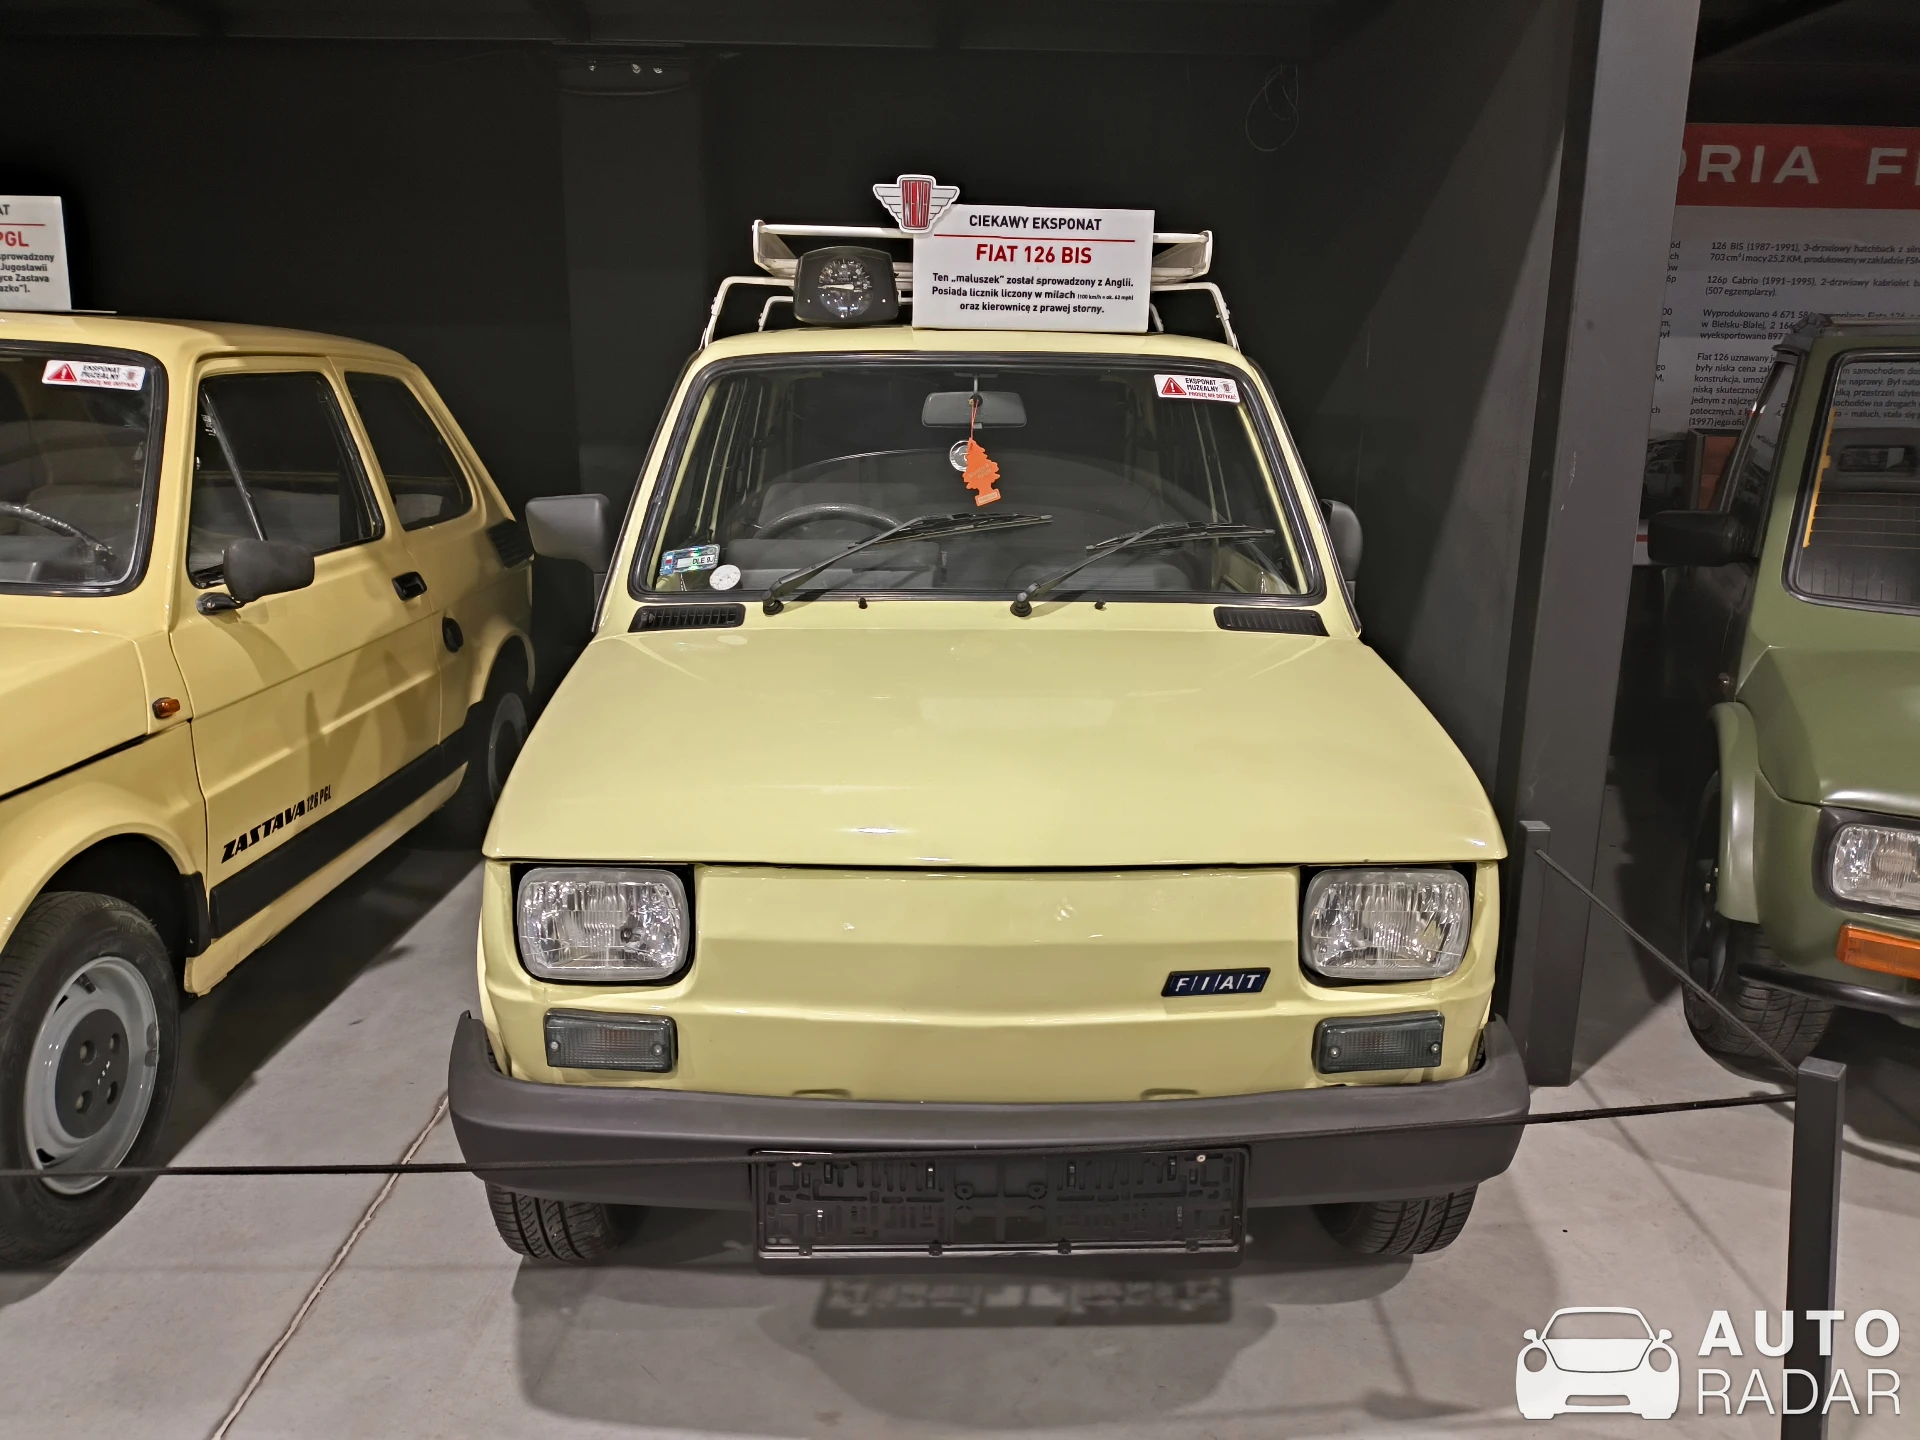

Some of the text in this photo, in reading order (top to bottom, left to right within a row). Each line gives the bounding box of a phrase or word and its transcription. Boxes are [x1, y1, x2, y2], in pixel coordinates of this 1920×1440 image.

[969, 215, 1102, 231] CIEKAWY EKSPONAT
[1711, 242, 1727, 250] 126
[1730, 242, 1744, 250] BIS
[1854, 245, 1895, 253] hatchback
[976, 244, 1092, 264] FIAT 126 BIS
[1710, 253, 1726, 261] 703
[1745, 255, 1767, 264] mocy
[15, 274, 50, 283] Zastava
[932, 272, 949, 282] Ten
[1006, 276, 1034, 285] został
[1036, 277, 1096, 288] sprowadzony
[1097, 279, 1103, 287] z
[1104, 277, 1134, 288] Anglii.
[1707, 276, 1728, 285] 126p
[1732, 276, 1758, 285] Cabrio
[932, 286, 968, 297] Posiada
[969, 288, 999, 297] licznik
[1001, 289, 1032, 300] liczony
[1034, 291, 1042, 299] w
[1044, 290, 1076, 299] milach
[1705, 287, 1724, 296] (507
[982, 302, 1031, 313] kierownicę
[1032, 304, 1038, 312] z
[1039, 304, 1071, 314] prawej
[1072, 304, 1105, 315] storny.
[1703, 309, 1770, 319] Wyprodukowano
[1771, 310, 1777, 318] 4
[1779, 310, 1795, 319] 671
[1769, 321, 1776, 330] 2
[1700, 331, 1783, 341] wyeksportowano 897
[1697, 352, 1712, 361] Fiat
[1714, 353, 1729, 361] 126
[1730, 355, 1770, 363] uznawany
[1695, 364, 1713, 373] były
[1852, 367, 1905, 375] samochodem
[1185, 377, 1217, 386] EKSPONAT
[1186, 385, 1219, 393] MUZEALNY
[1693, 386, 1760, 394] niską skutecznoś
[1690, 396, 1720, 405] jednym
[1688, 417, 1714, 427] (1997)
[1714, 419, 1731, 427] jego
[221, 800, 306, 864] ZASTAVA
[319, 784, 331, 805] PGL
